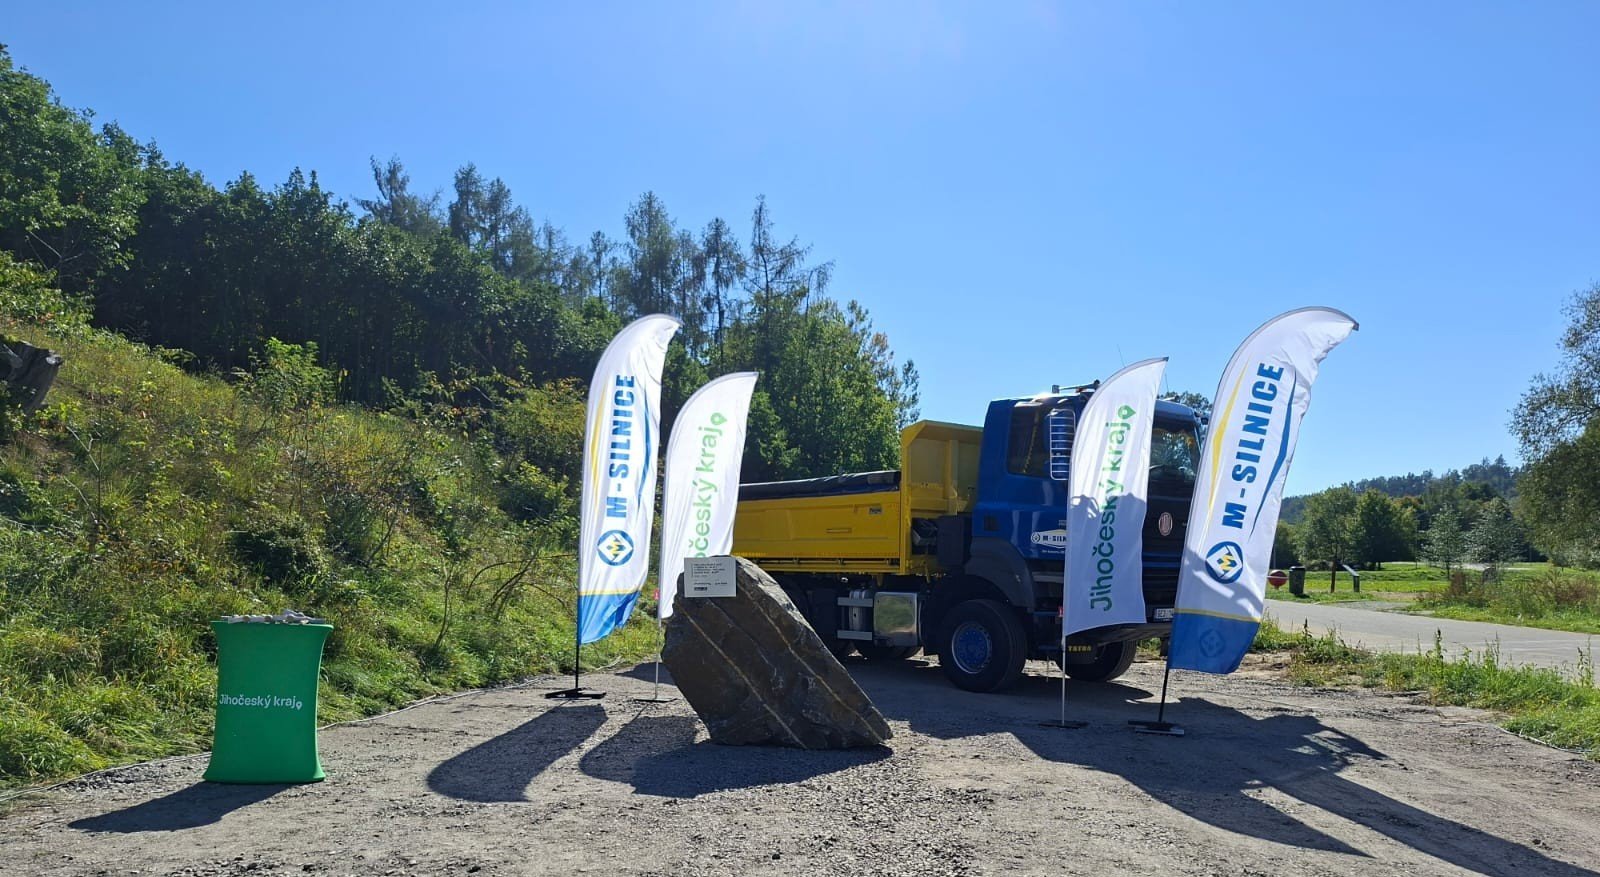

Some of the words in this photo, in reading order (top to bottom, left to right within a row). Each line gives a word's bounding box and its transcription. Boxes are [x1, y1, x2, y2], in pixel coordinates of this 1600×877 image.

[695, 426, 723, 473] kraj
[1102, 420, 1131, 472] kraj
[1090, 479, 1124, 612] Jihočeský
[219, 694, 272, 709] Jihočeský
[273, 695, 297, 709] kraj
